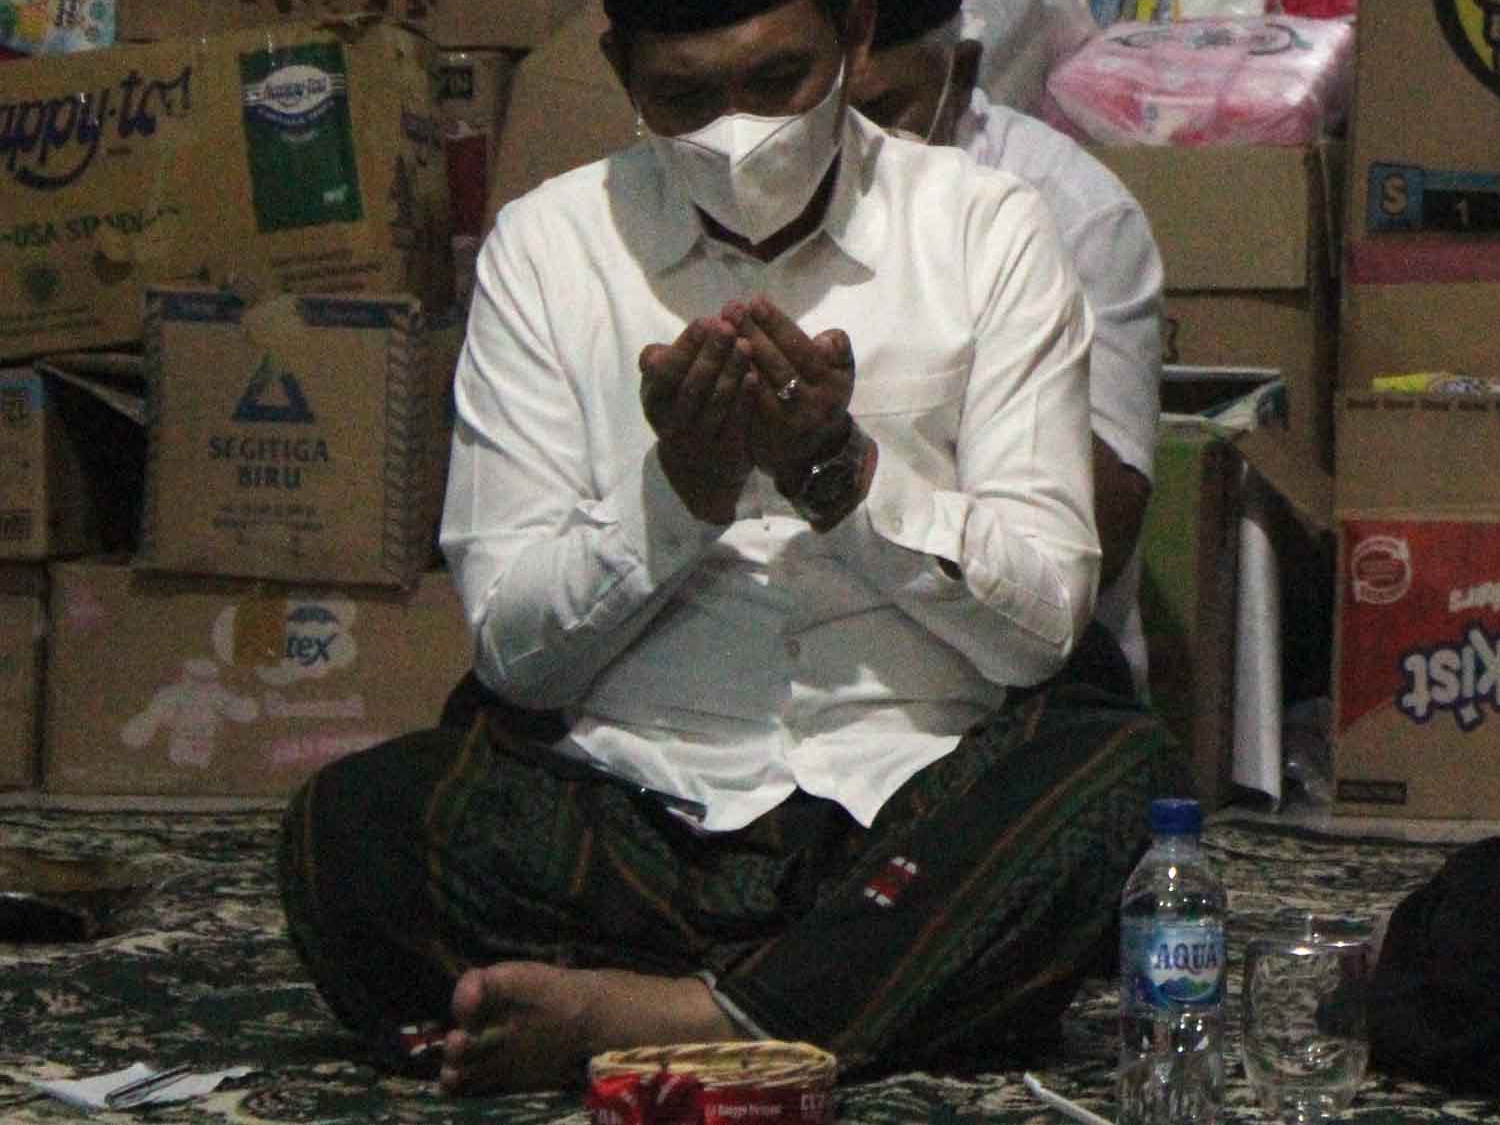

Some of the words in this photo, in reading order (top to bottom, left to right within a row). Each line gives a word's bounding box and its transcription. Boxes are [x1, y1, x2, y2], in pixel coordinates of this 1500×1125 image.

[1381, 174, 1408, 217] S
[208, 434, 330, 464] SEGITIGA
[1153, 941, 1218, 976] AQUA
